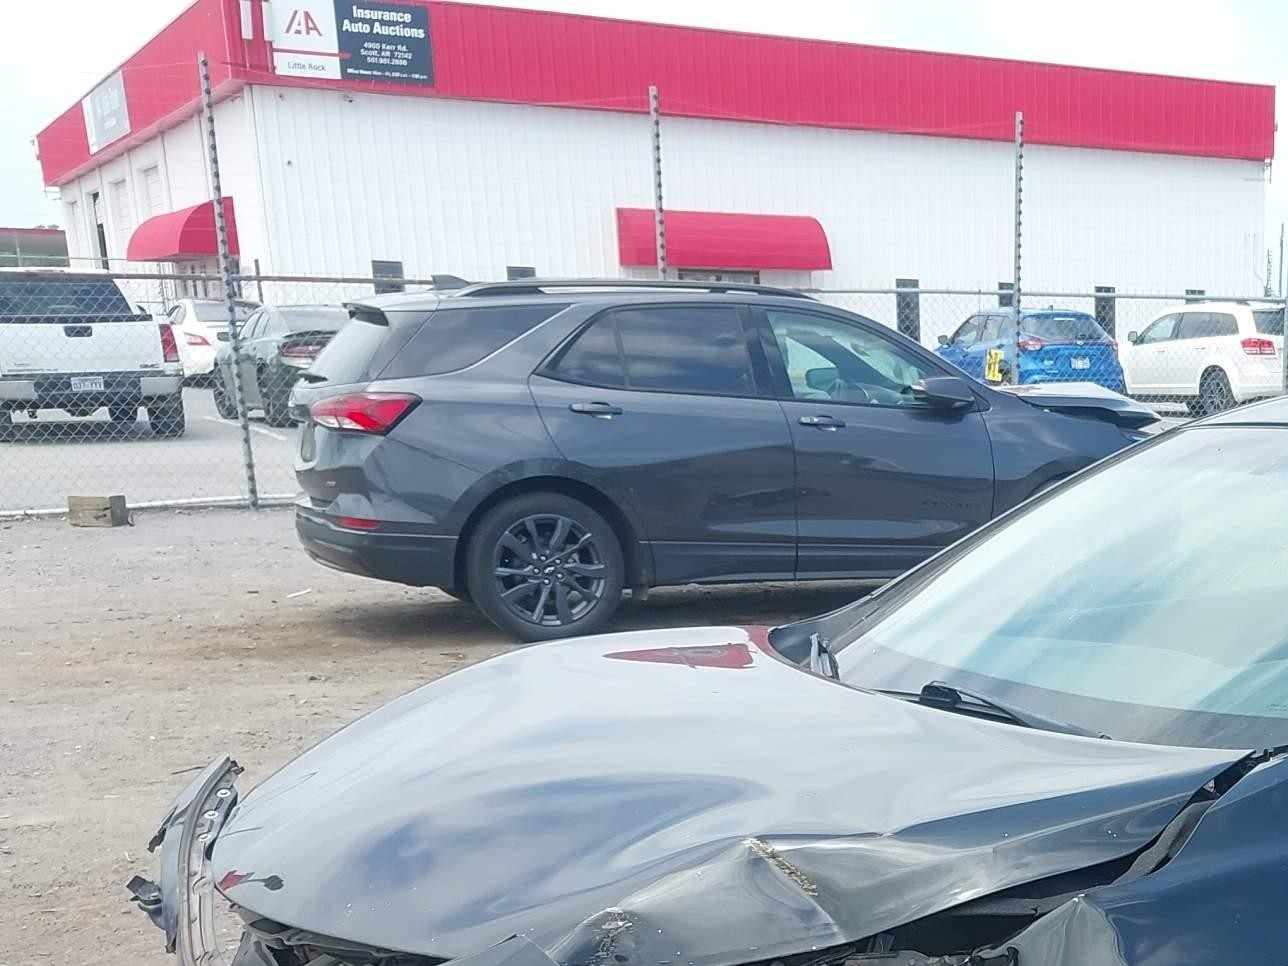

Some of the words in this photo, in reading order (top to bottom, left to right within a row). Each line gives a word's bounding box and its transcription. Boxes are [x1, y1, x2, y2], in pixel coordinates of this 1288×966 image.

[352, 5, 412, 23] Insurance
[342, 20, 371, 34] Auto
[373, 22, 425, 39] Auctions
[381, 43, 396, 51] Kerr
[288, 61, 306, 71] Little
[308, 62, 327, 72] Rock
